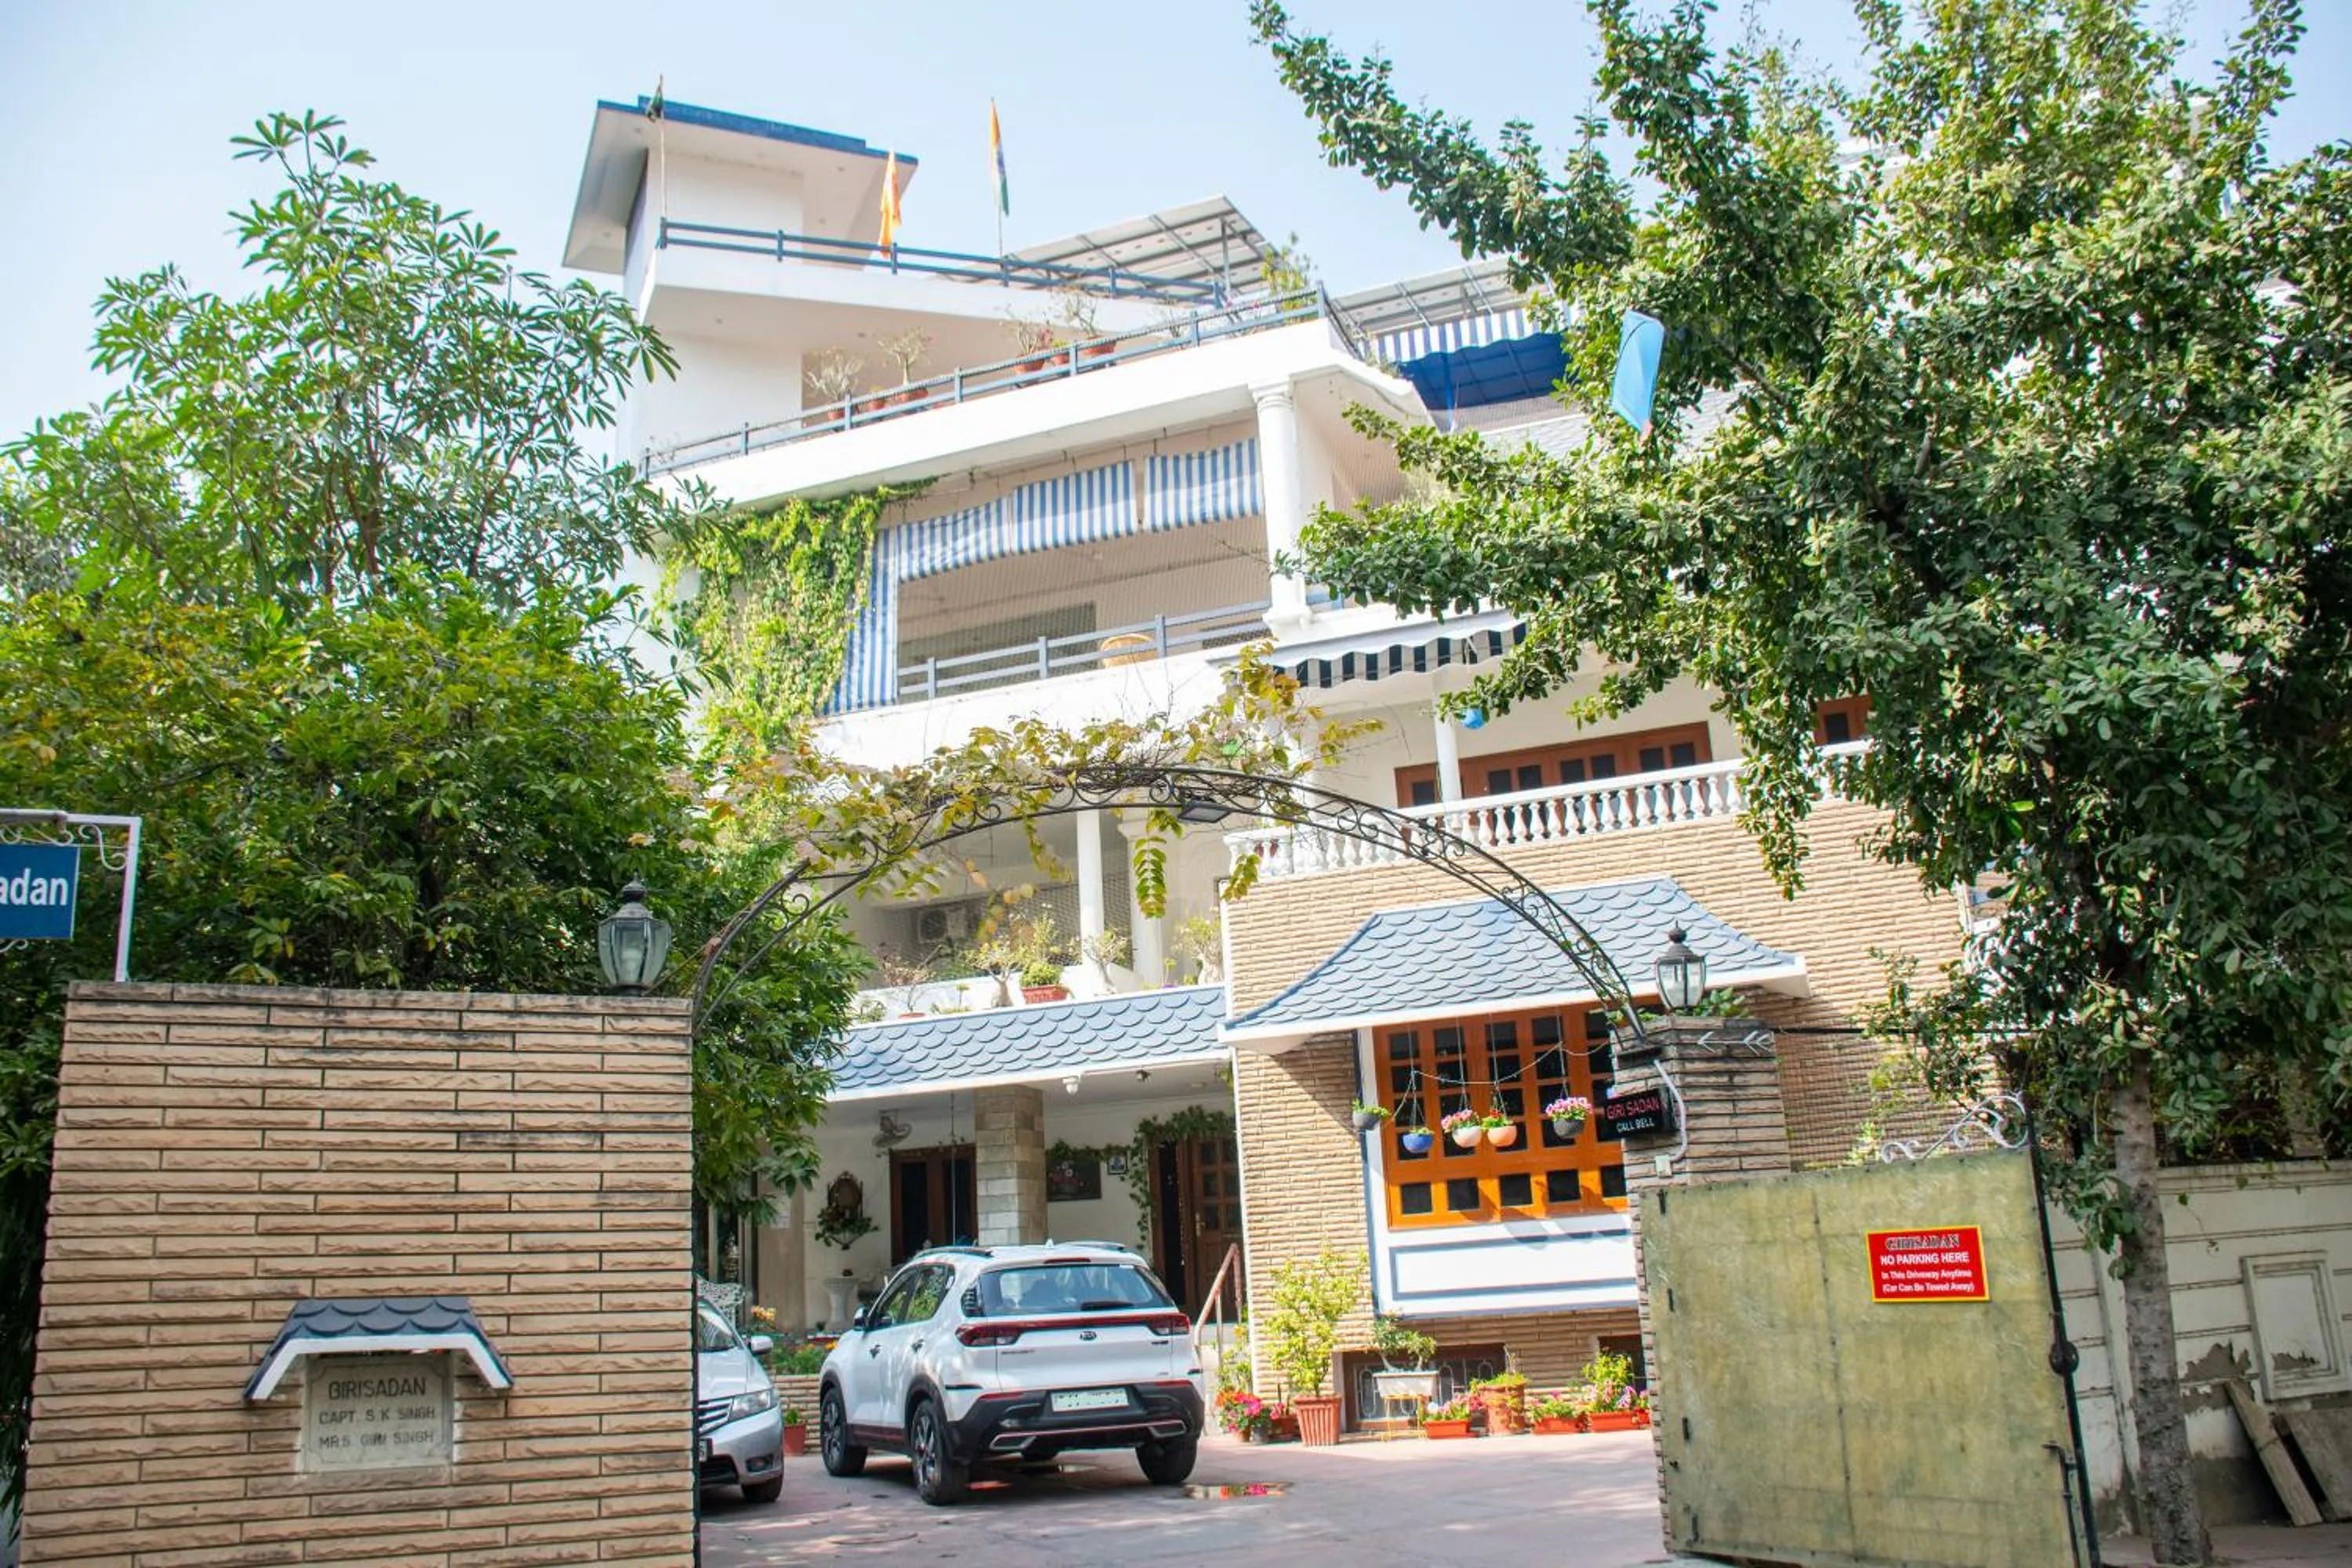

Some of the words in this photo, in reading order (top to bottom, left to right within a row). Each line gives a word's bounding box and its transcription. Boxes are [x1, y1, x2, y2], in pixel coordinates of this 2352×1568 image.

[1617, 1121, 1635, 1132] CALL
[1635, 1117, 1654, 1128] BELL
[1880, 1254, 1895, 1265] NO
[1896, 1253, 1939, 1265] PARKING
[1940, 1251, 1969, 1263] HERE
[1889, 1270, 1905, 1279] This
[1907, 1269, 1939, 1279] Driveway
[1940, 1269, 1972, 1279] Anytime
[1898, 1283, 1914, 1292] Can
[1914, 1282, 1925, 1291] Be
[1925, 1282, 1950, 1291] Towed
[328, 1377, 426, 1399] GIRISADAN
[398, 1406, 435, 1419] SINGH
[393, 1429, 434, 1443] SINGH
